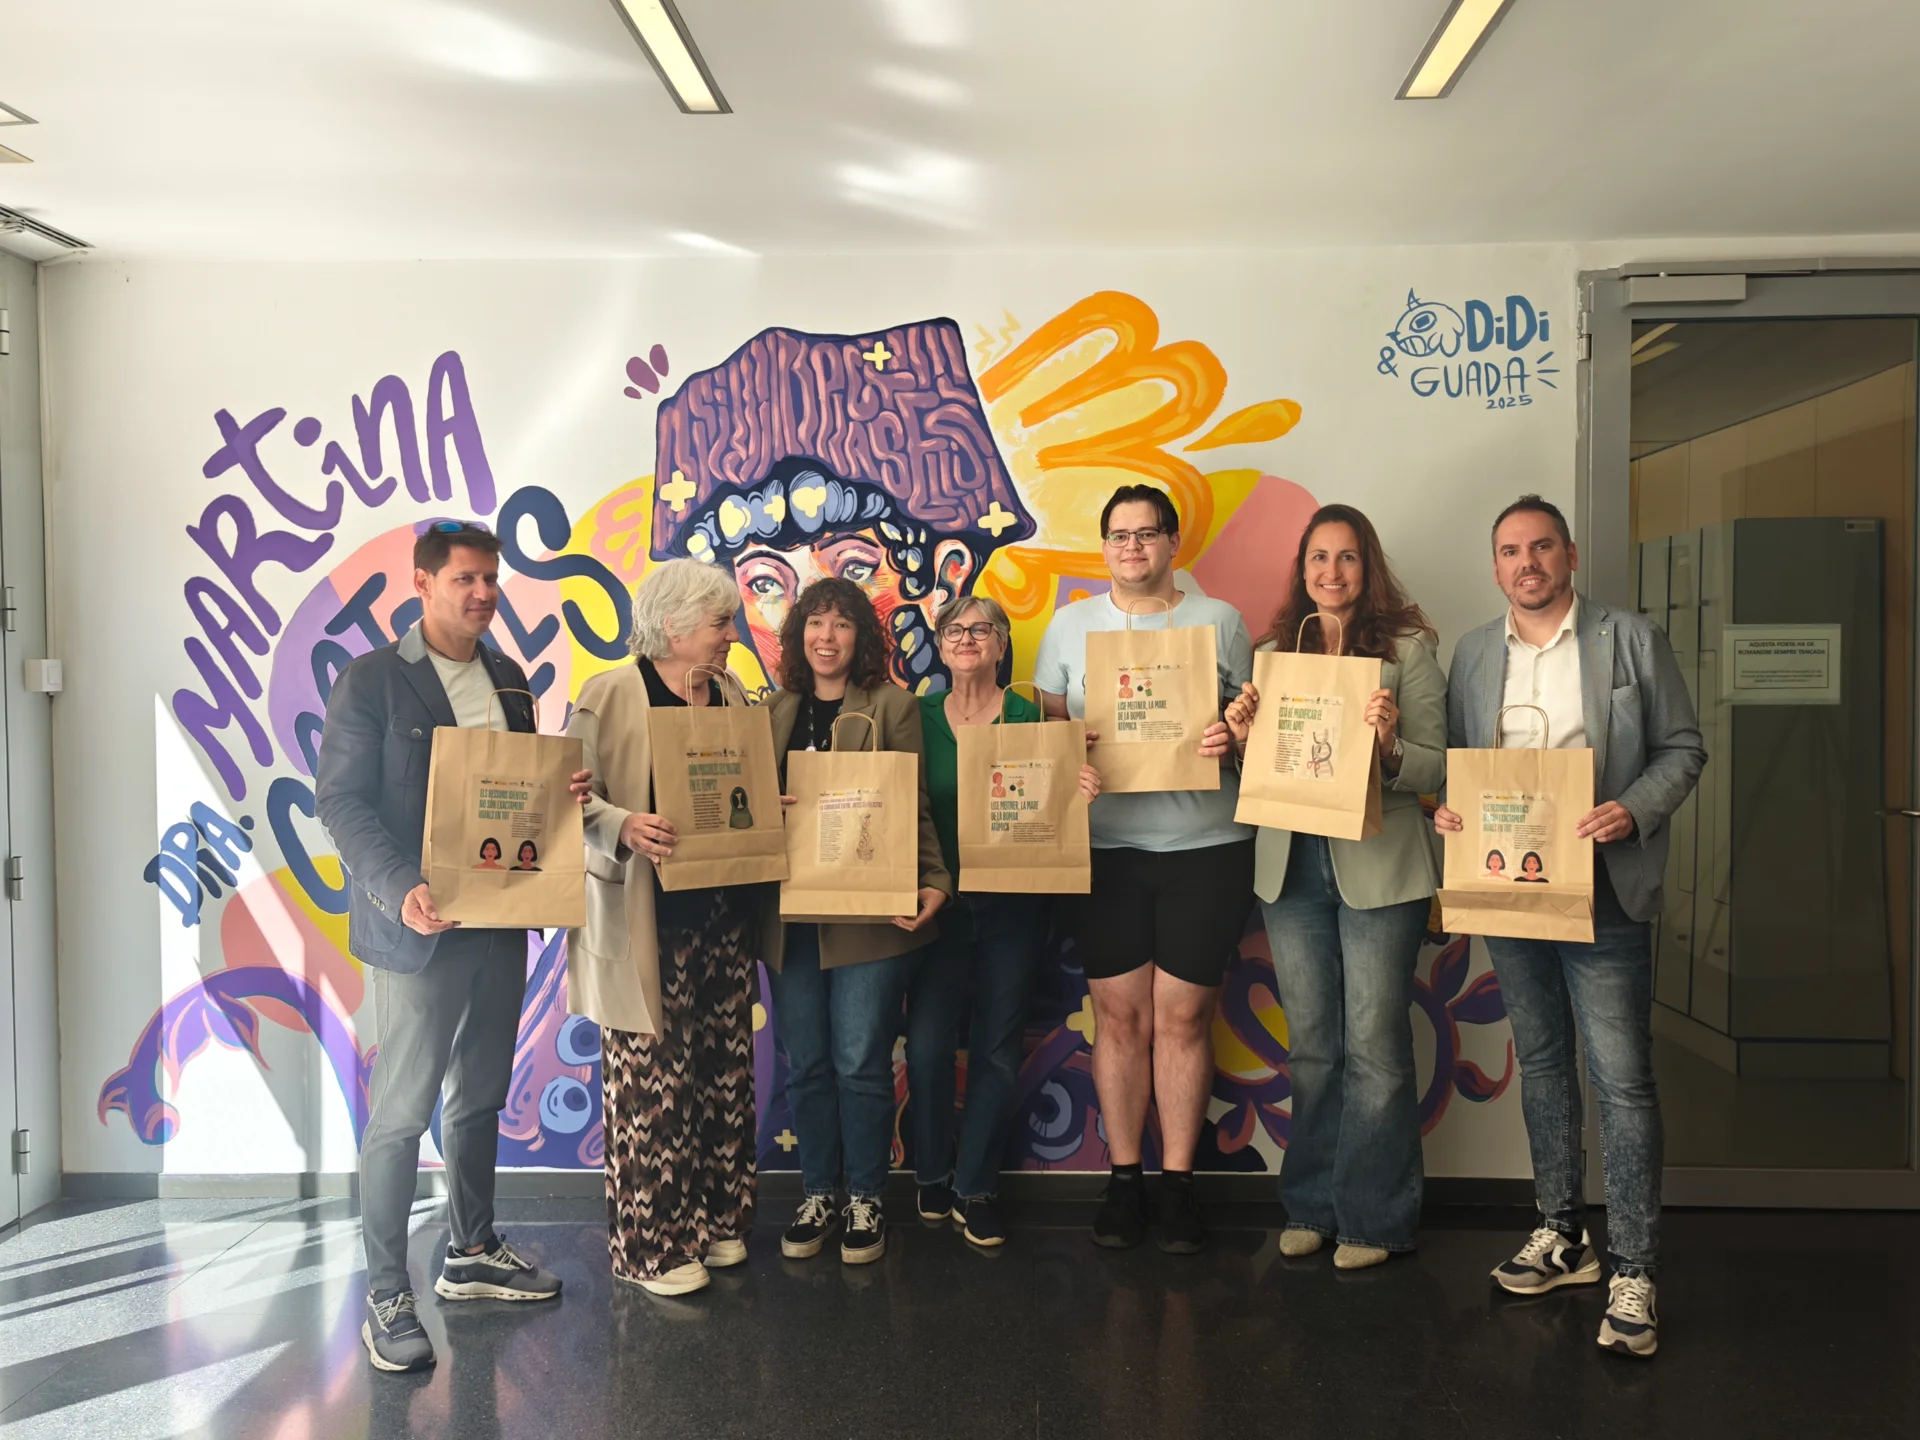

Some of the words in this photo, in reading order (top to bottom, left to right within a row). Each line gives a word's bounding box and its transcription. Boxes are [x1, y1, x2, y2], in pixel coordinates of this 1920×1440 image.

[1465, 295, 1550, 352] DiDi
[1377, 346, 1399, 378] &
[1410, 357, 1531, 398] GUADA
[1485, 394, 1533, 410] 2025
[1148, 700, 1155, 709] LA
[1118, 712, 1124, 721] DE
[1124, 712, 1130, 720] LA
[1020, 801, 1026, 810] LA
[143, 800, 255, 928] DRA.
